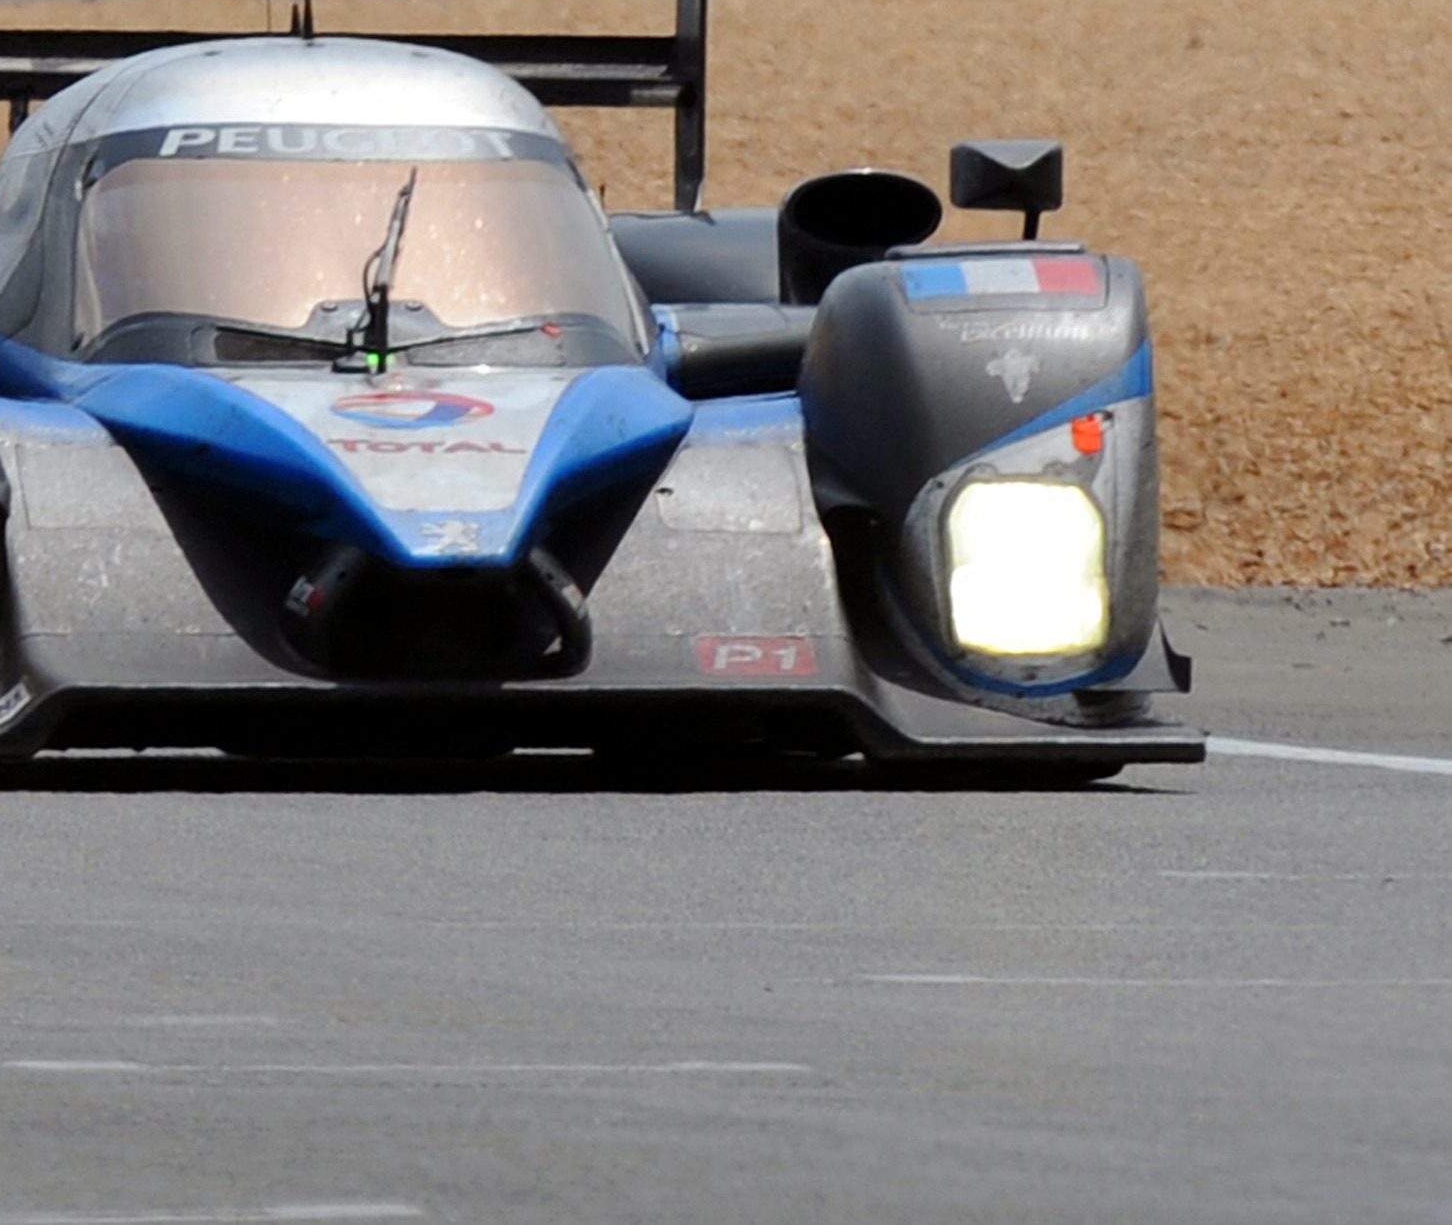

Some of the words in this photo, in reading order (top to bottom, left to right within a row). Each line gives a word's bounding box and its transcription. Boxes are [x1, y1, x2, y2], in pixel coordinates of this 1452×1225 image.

[158, 126, 513, 158] PEUGEOT
[326, 438, 527, 454] TOTAL
[714, 643, 799, 670] P1
